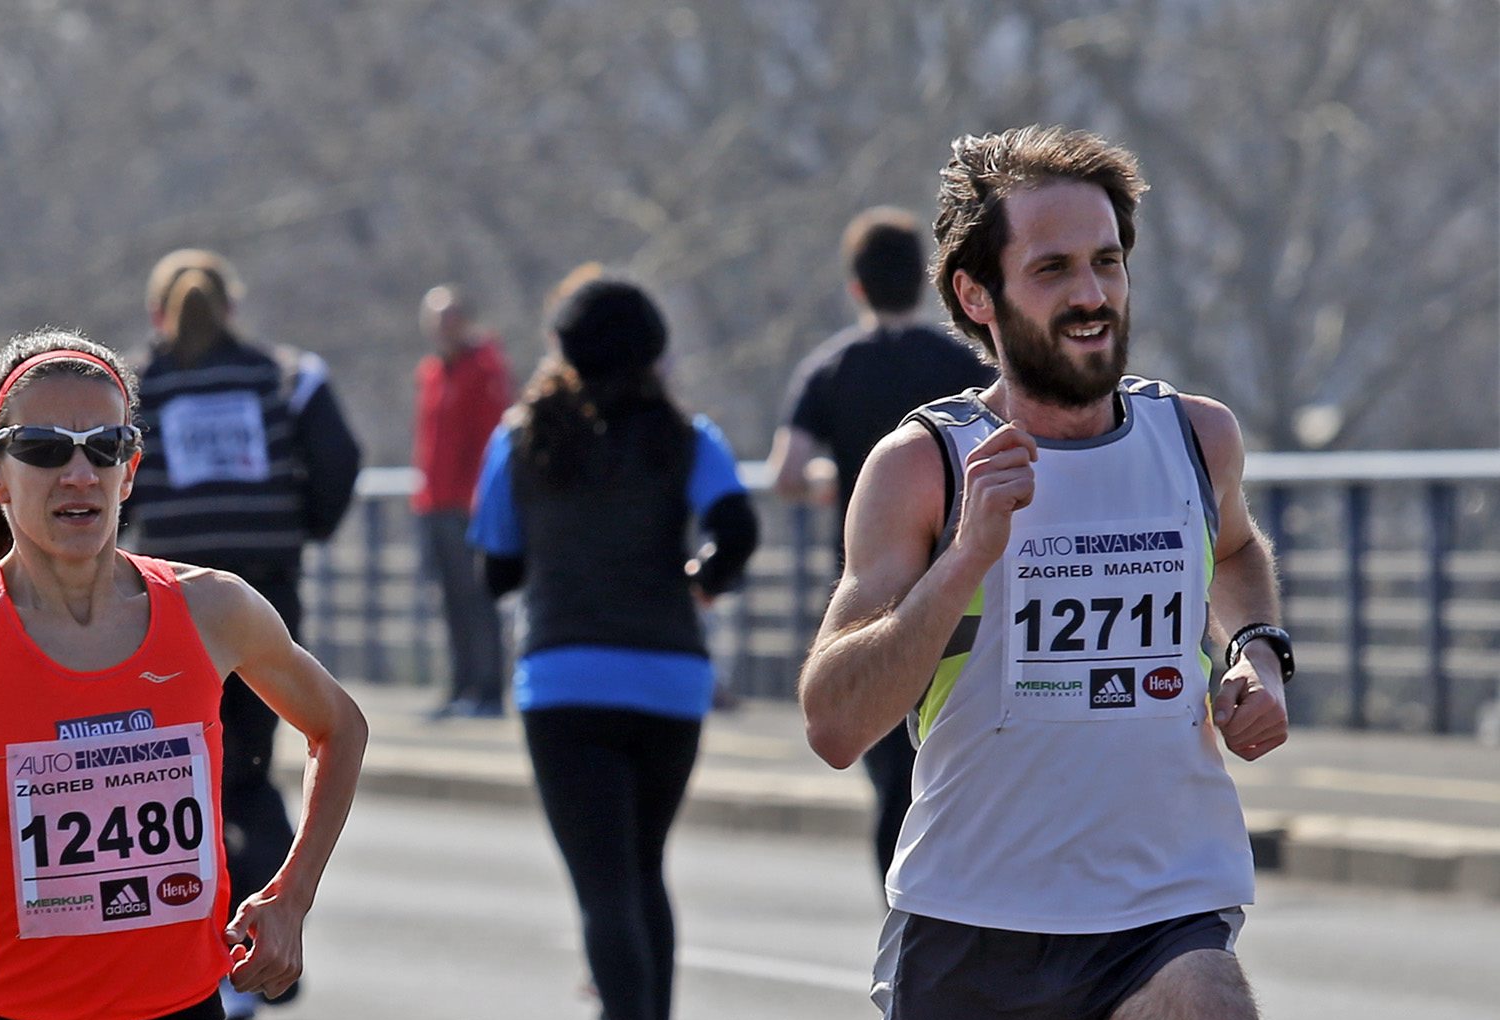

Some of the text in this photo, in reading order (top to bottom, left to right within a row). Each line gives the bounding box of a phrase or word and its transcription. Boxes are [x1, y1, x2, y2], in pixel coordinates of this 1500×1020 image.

[1018, 560, 1184, 579] ZAGREB MARATON
[1014, 591, 1182, 652] 12711
[1015, 681, 1083, 690] MERKUR
[1150, 675, 1182, 692] Hervis
[1093, 693, 1132, 704] adidas
[58, 719, 125, 740] Allianz
[16, 765, 193, 797] ZAGREB MARATON
[20, 796, 203, 868] 12480
[163, 881, 200, 902] Hervis
[26, 895, 94, 908] MERKUR
[106, 900, 147, 916] adidas
